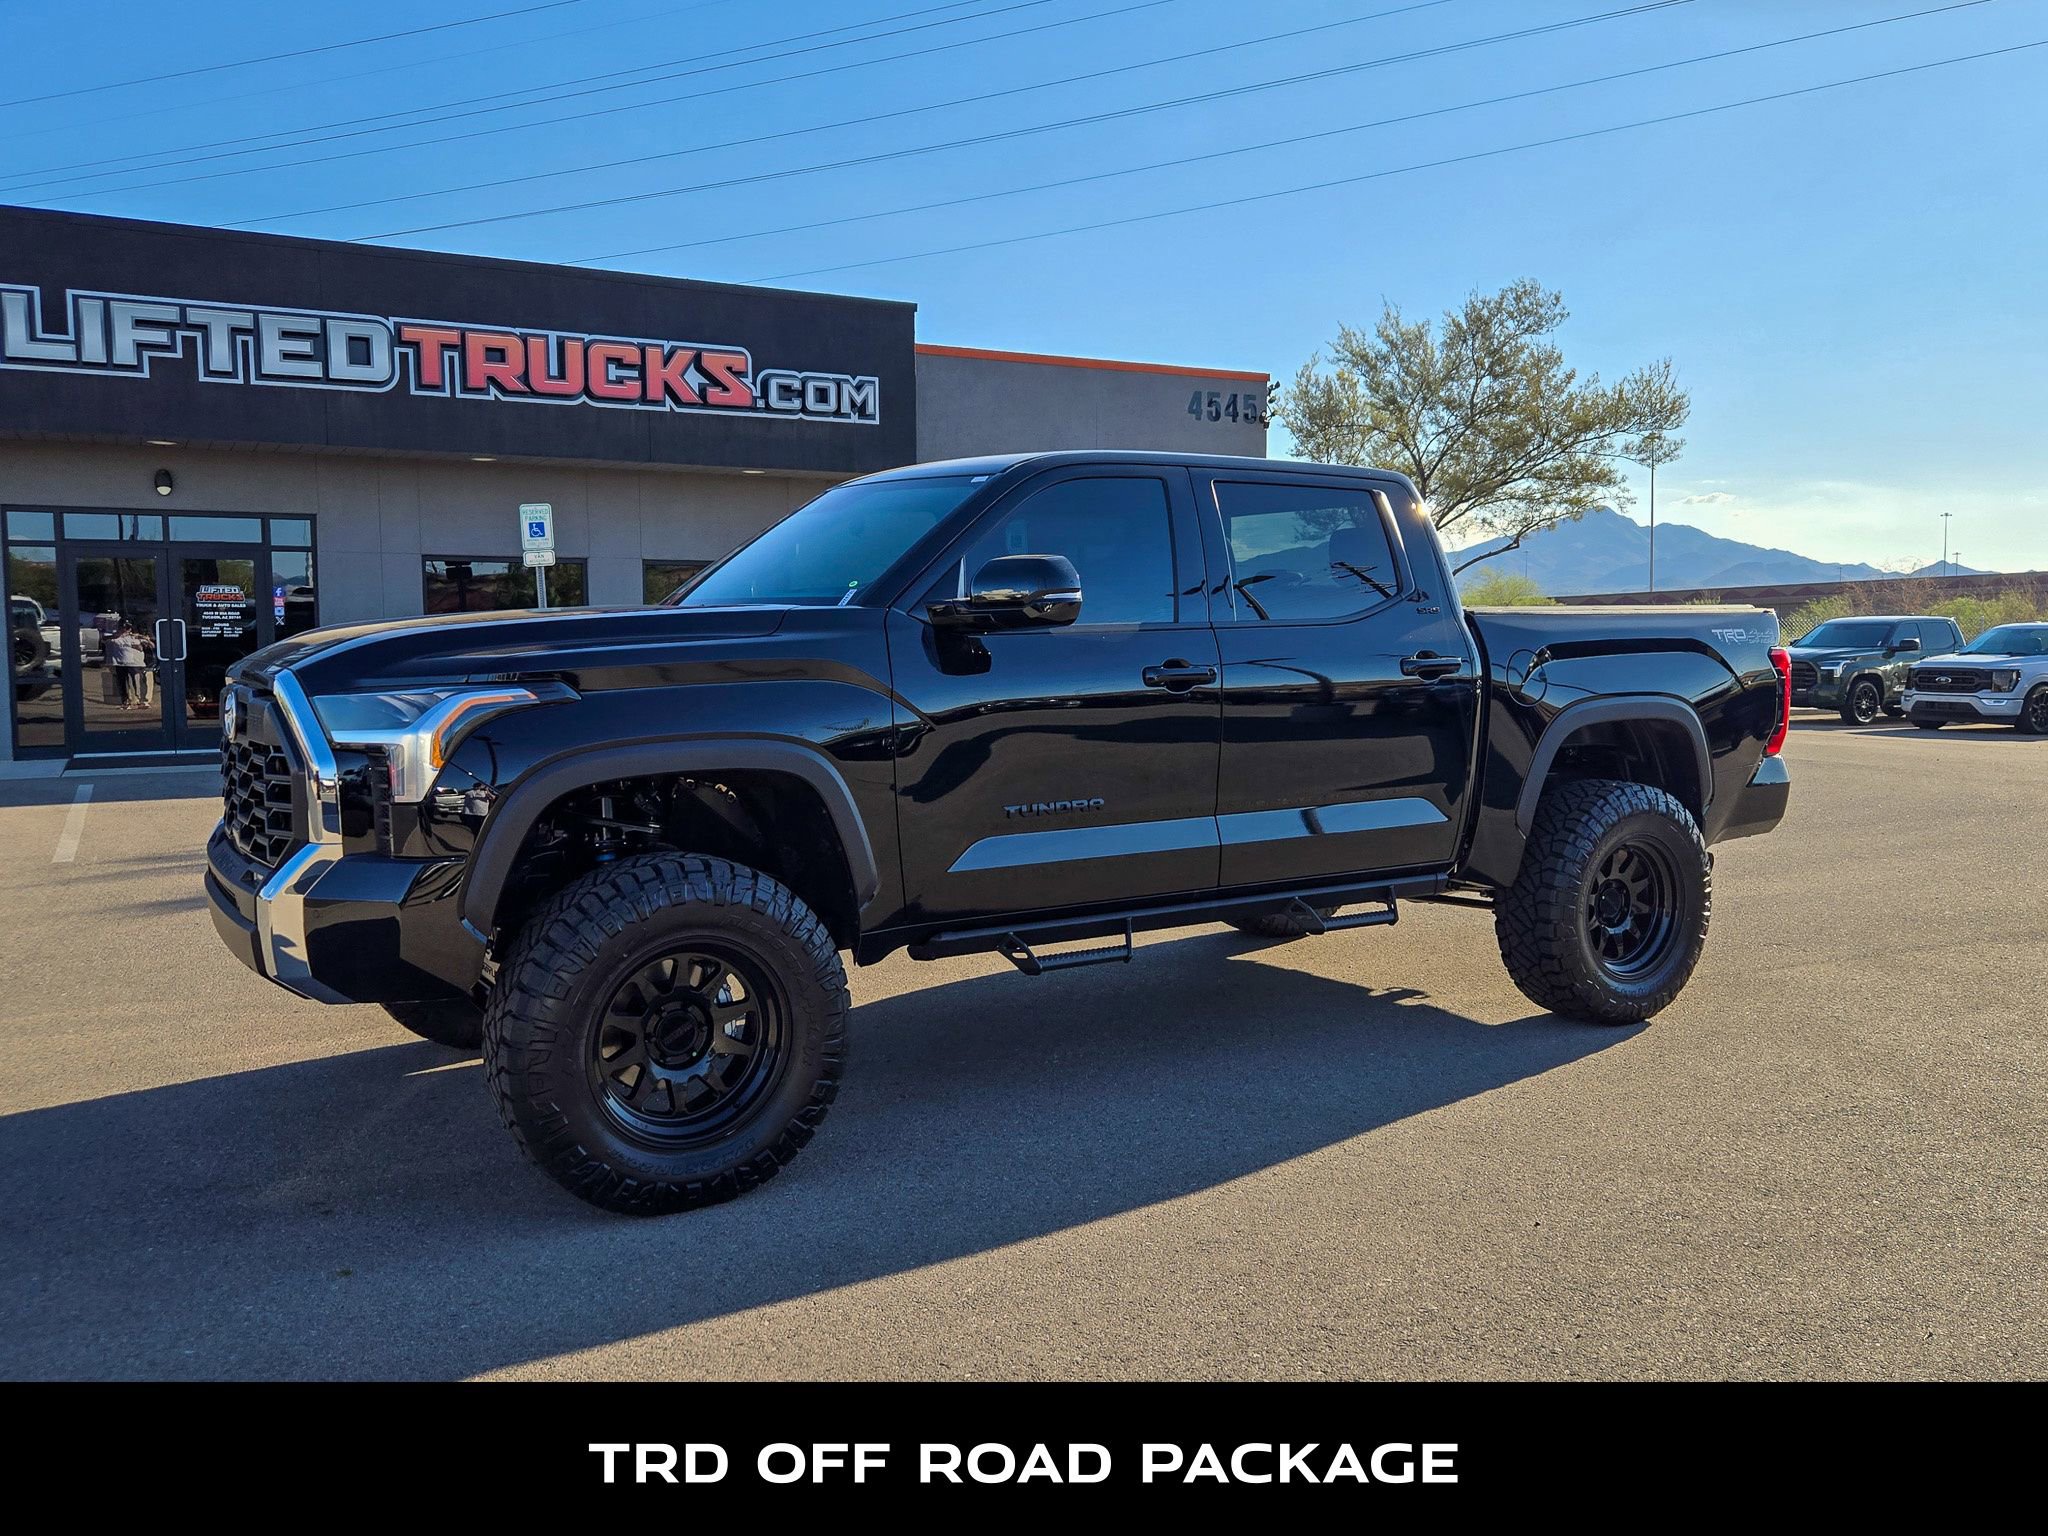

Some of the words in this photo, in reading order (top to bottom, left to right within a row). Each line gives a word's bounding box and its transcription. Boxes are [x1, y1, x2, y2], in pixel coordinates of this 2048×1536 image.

[1187, 390, 1258, 424] 4545
[198, 593, 244, 601] TRUCKS
[201, 586, 240, 594] LIFTED
[1711, 628, 1747, 643] TRD
[1003, 798, 1105, 818] TUNDRA
